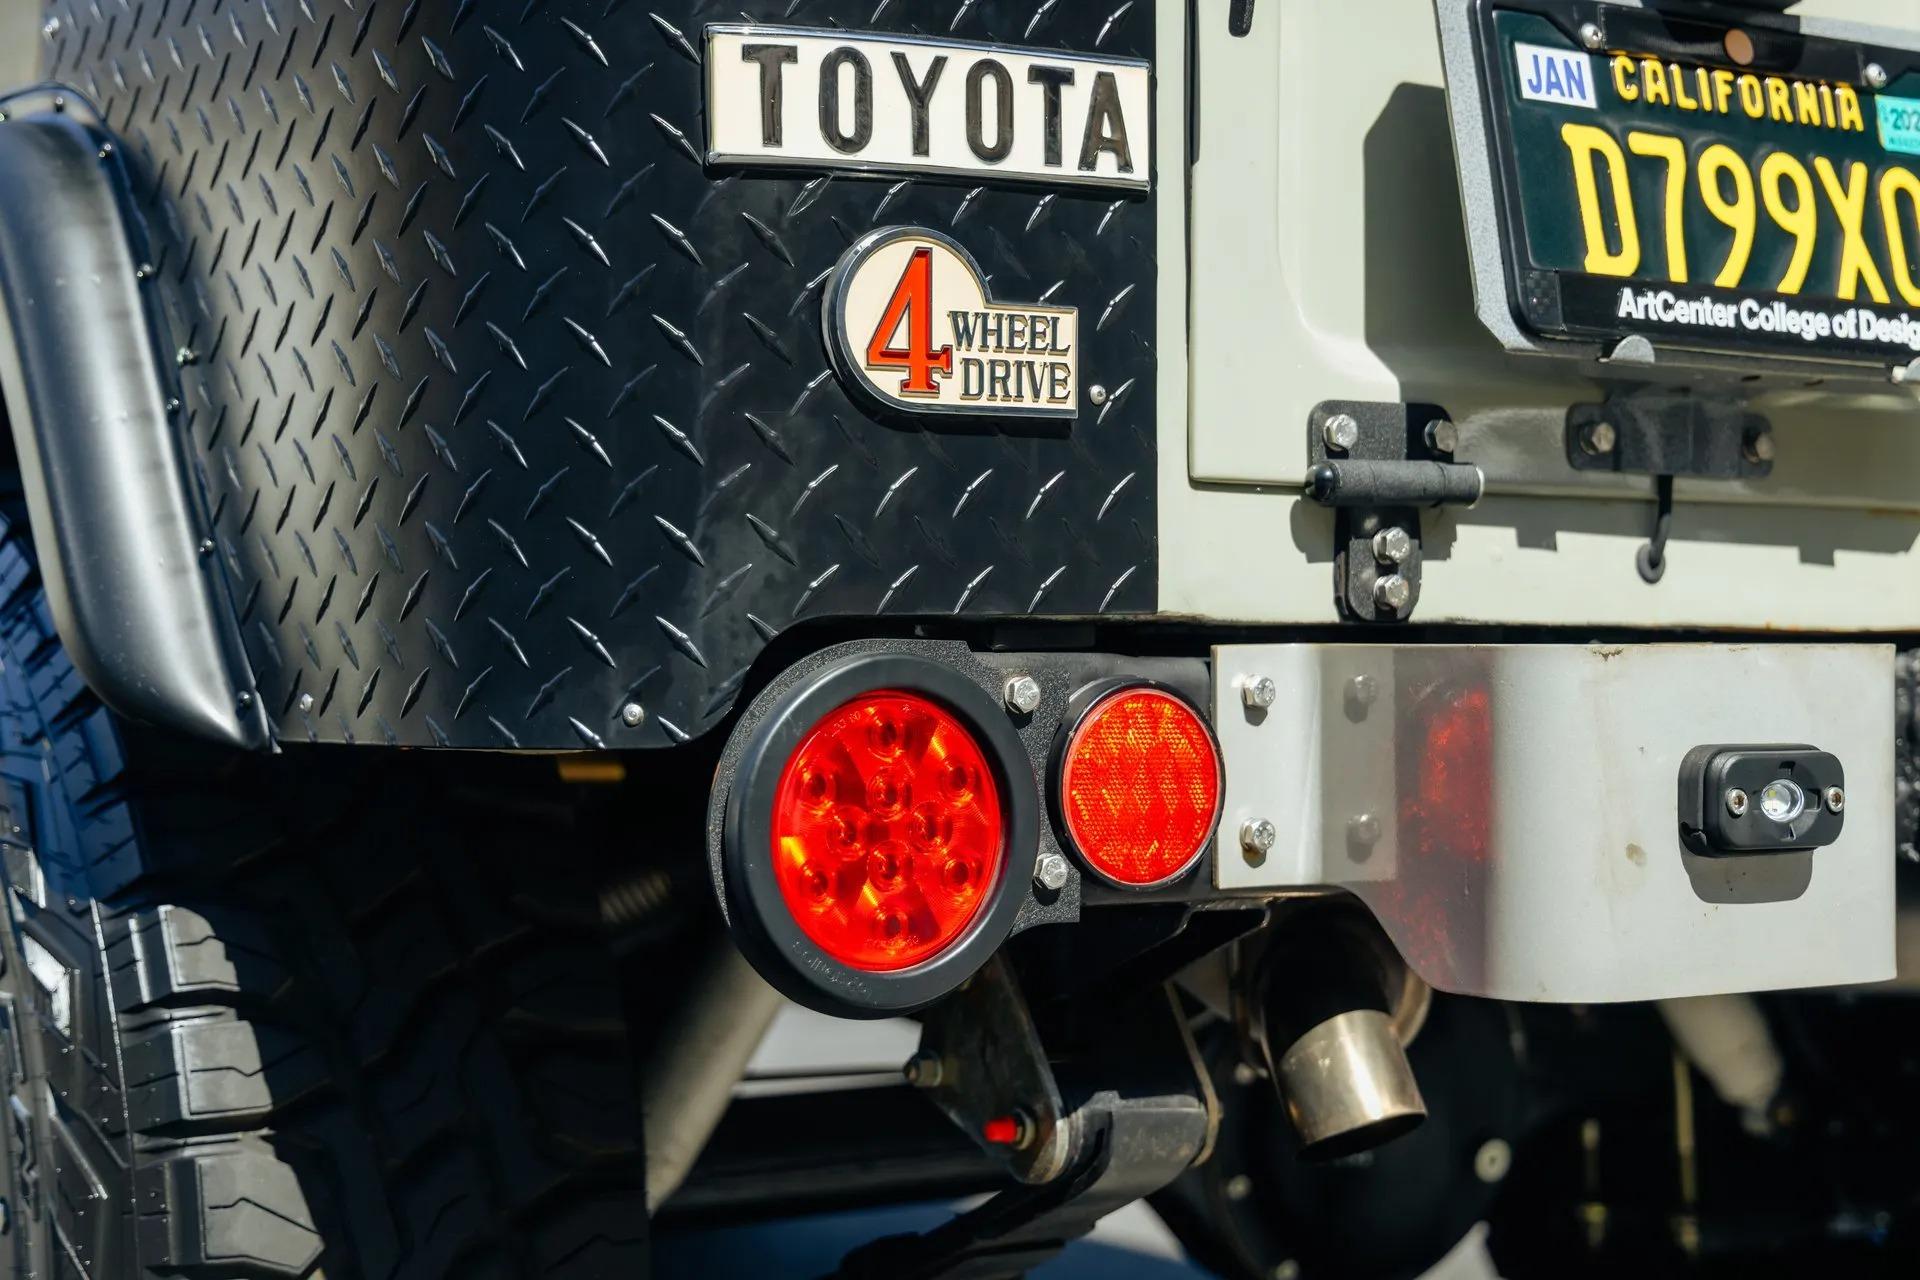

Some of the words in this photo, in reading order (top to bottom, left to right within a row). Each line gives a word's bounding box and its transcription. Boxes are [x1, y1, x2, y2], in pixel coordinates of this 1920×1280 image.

[1526, 54, 1587, 100] JAN
[1611, 54, 1865, 132] CALIFORNIA
[742, 43, 1135, 174] TOYOTA
[865, 246, 954, 398] 4
[947, 310, 1072, 356] WHEEL
[1617, 287, 1738, 329] ArtCenter
[1739, 298, 1832, 341] College
[1831, 307, 1858, 339] of
[959, 357, 1072, 404] DRIVE
